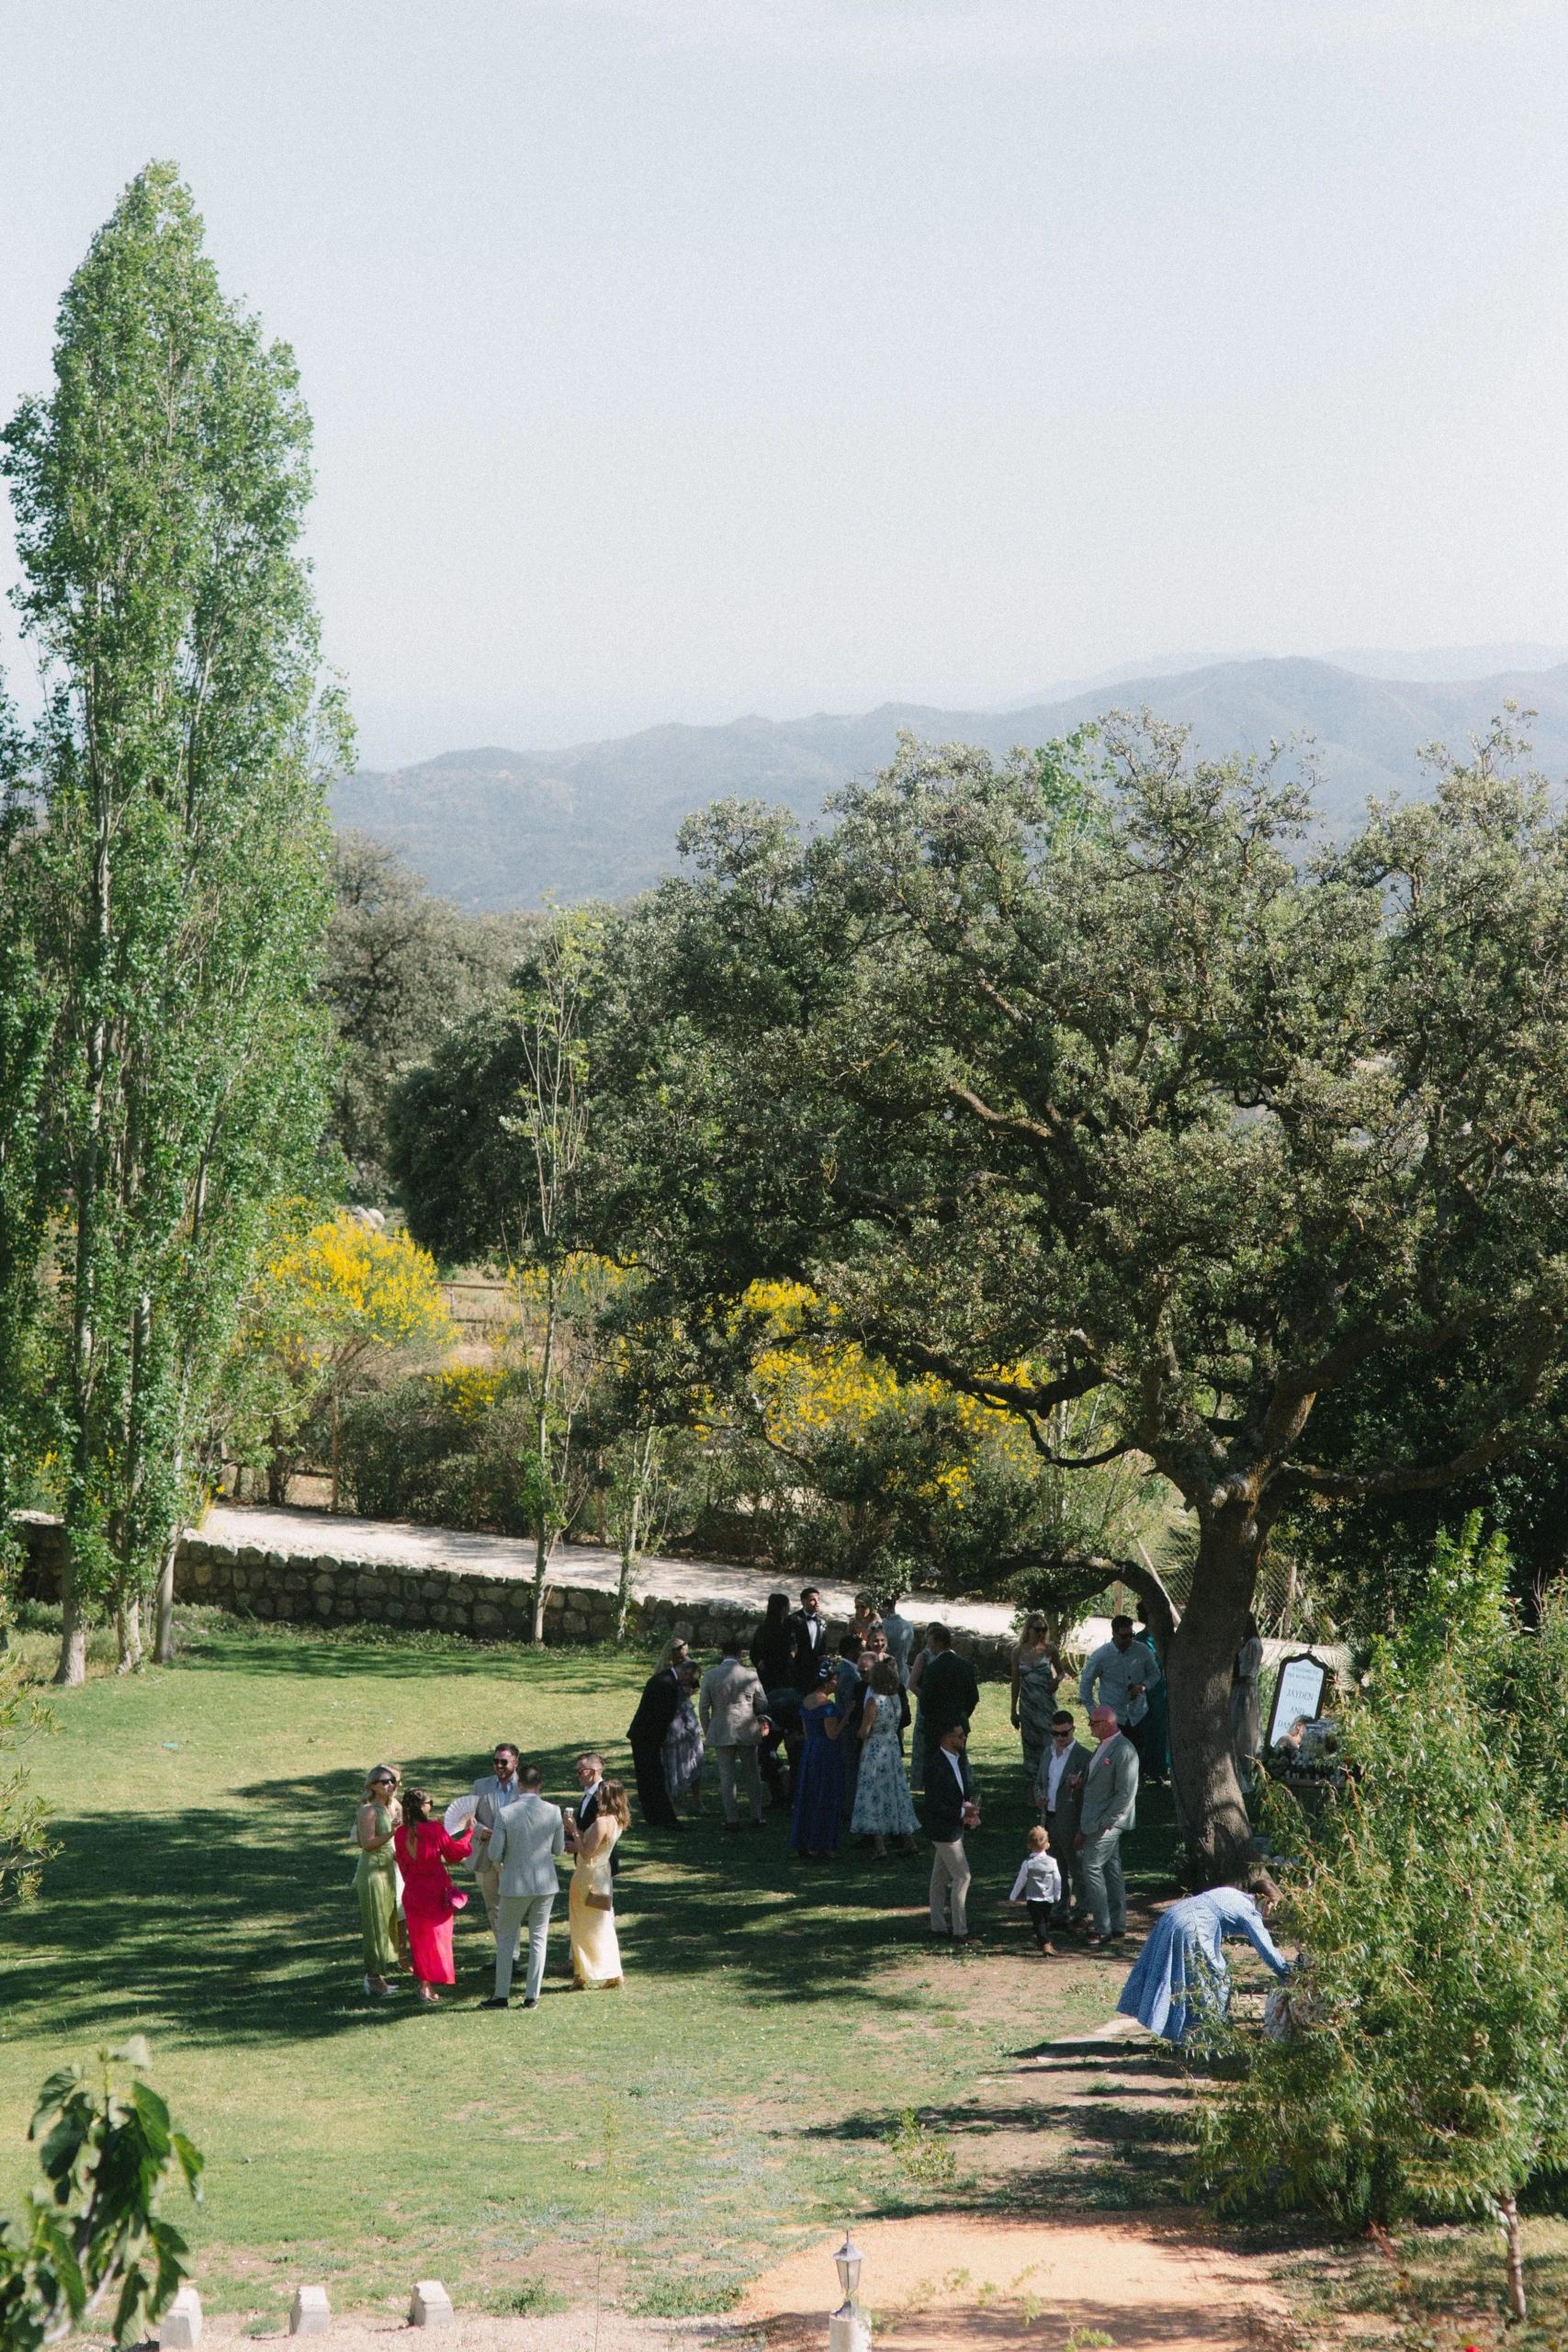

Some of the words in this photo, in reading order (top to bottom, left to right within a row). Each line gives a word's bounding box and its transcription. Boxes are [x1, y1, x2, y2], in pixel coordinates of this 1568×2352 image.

[1292, 1666, 1312, 1674] WELCOME
[1296, 1673, 1315, 1681] WEDDING
[1286, 1689, 1314, 1701] JAYDEN
[1289, 1706, 1305, 1715] AND
